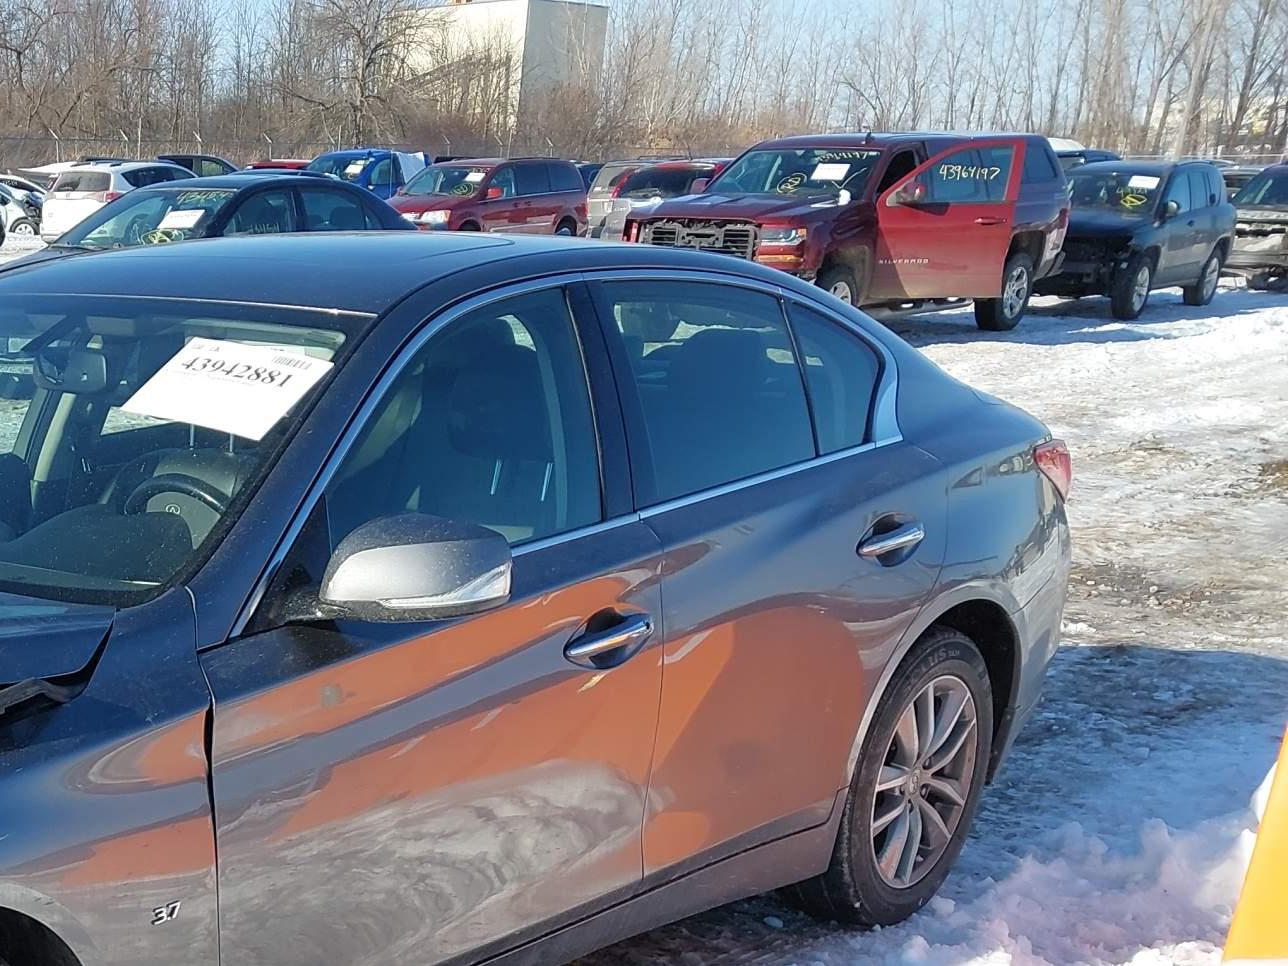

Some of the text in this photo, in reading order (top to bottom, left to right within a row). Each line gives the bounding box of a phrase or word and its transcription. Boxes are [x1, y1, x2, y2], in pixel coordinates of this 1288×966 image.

[939, 164, 1001, 181] 43964197
[181, 355, 294, 389] 43942881
[151, 900, 182, 926] 3.7
